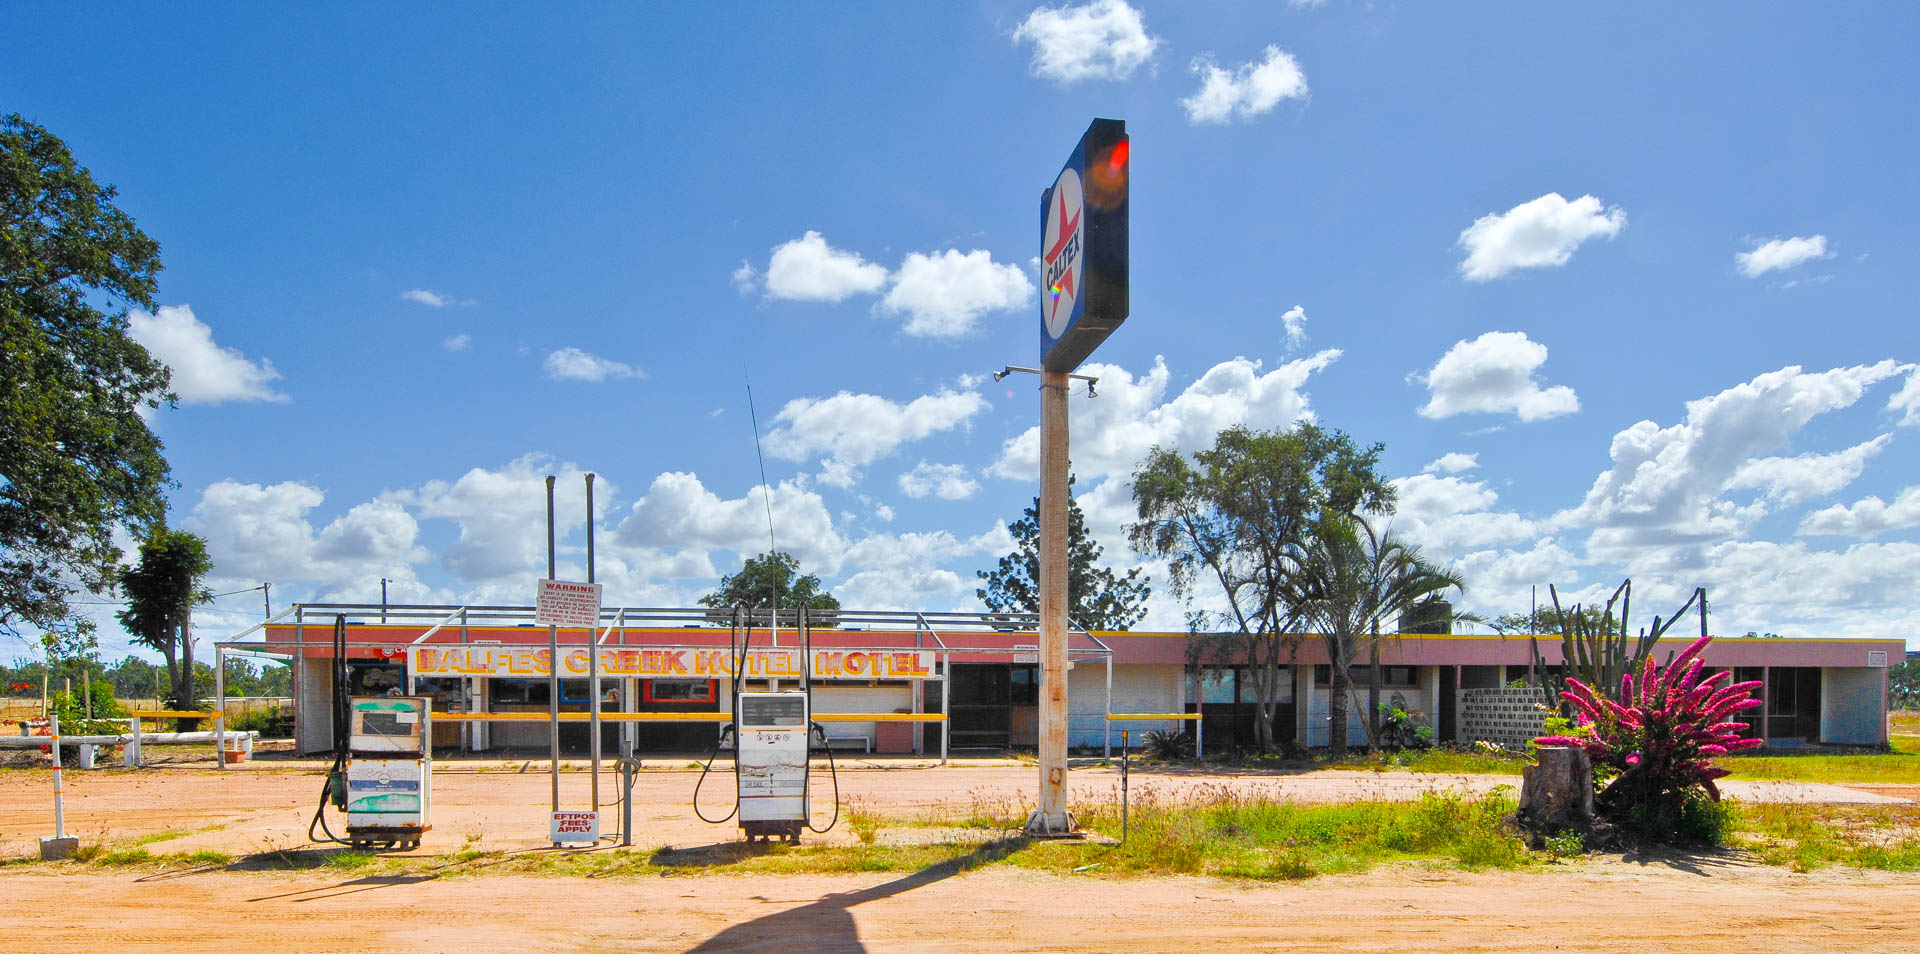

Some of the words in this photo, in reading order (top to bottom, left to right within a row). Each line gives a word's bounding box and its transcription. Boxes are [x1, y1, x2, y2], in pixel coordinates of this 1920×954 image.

[1047, 227, 1079, 291] CALTEX
[545, 583, 595, 592] WARNING
[416, 649, 552, 673] BALFES
[564, 649, 688, 674] CREEK
[695, 651, 802, 675] HOTEL
[815, 651, 929, 677] MOTEL
